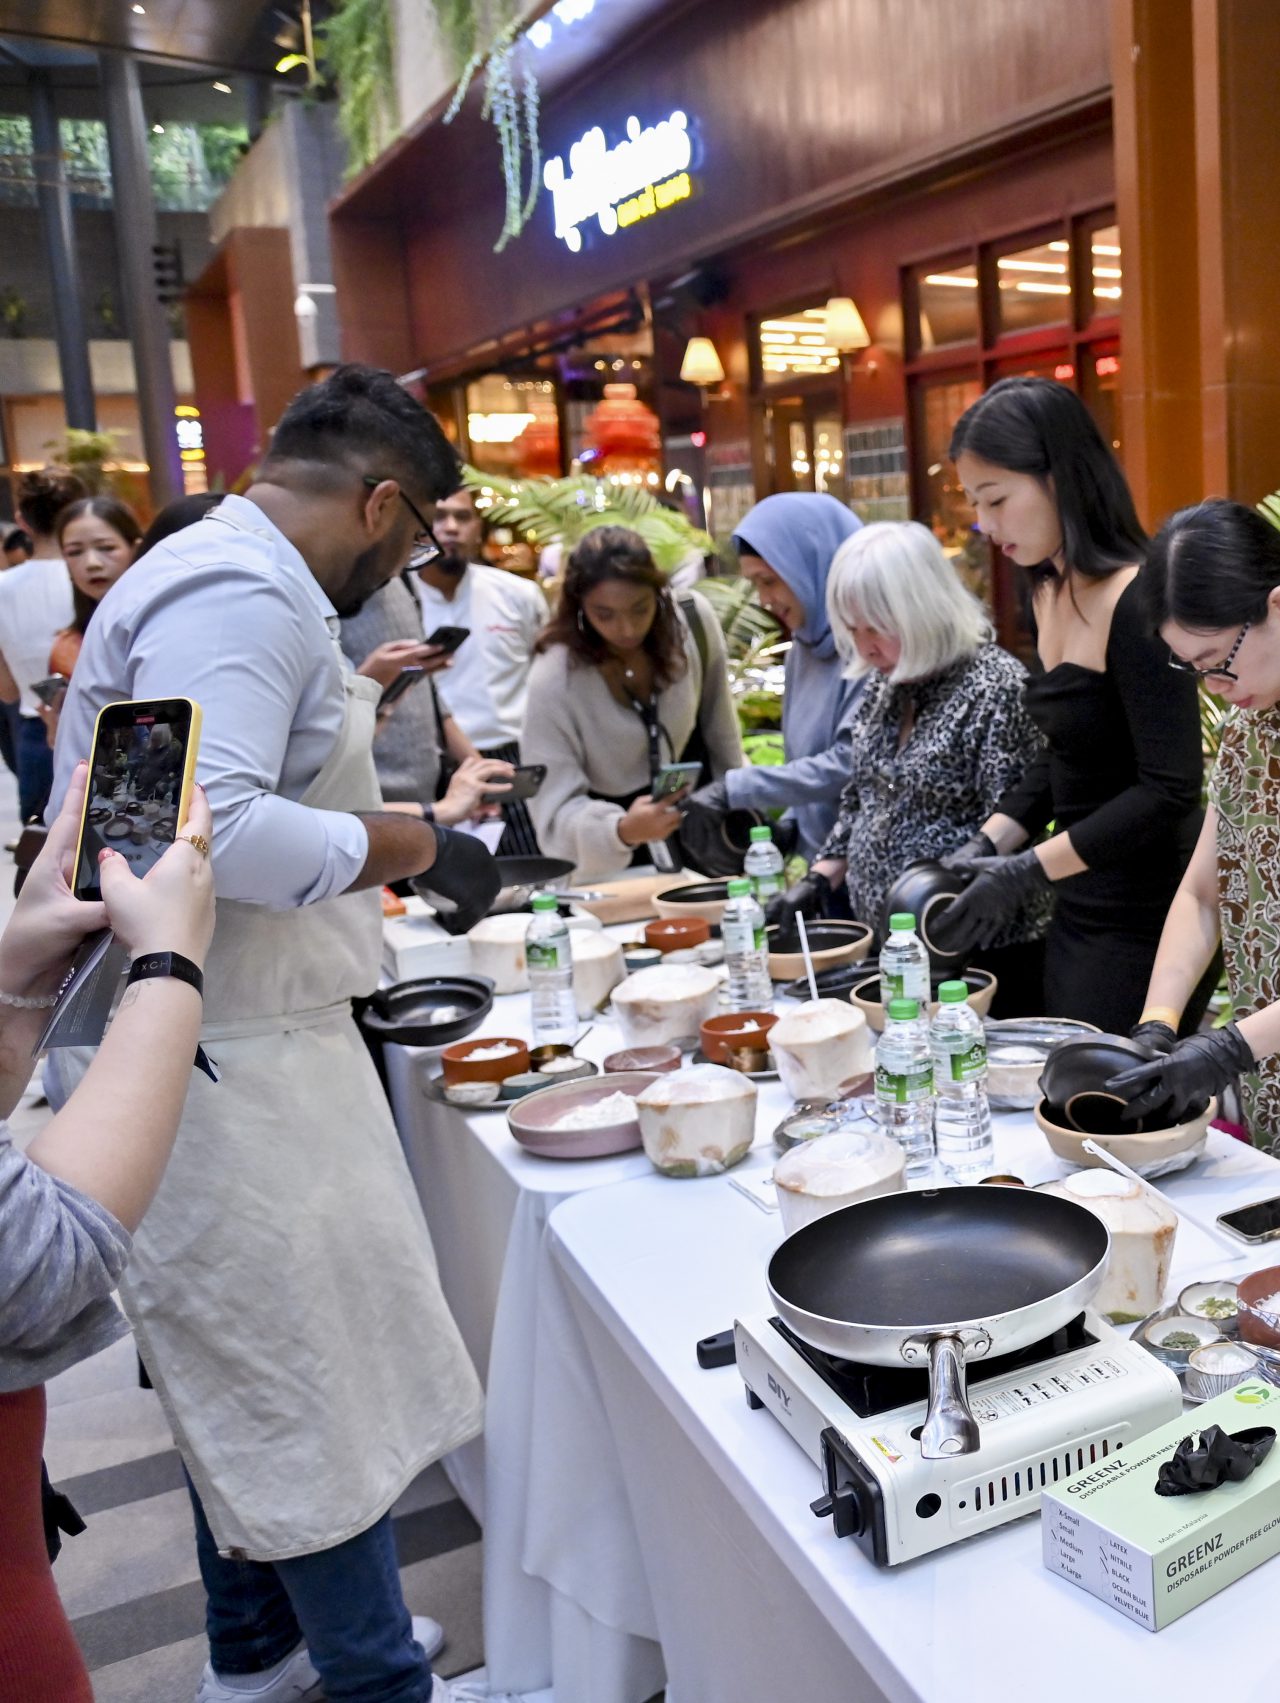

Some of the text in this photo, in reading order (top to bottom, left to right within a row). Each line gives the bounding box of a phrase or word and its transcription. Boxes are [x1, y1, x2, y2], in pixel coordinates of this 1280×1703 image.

[767, 1372, 791, 1408] DIY
[1067, 1459, 1128, 1494] GREENZ
[1079, 1471, 1126, 1500] DISPOSABLE
[1126, 1454, 1160, 1473] POWDER
[1156, 1443, 1179, 1456] FREE
[1059, 1508, 1080, 1527] X-Small
[1158, 1533, 1176, 1544] Made
[1182, 1513, 1209, 1530] Malaysia
[1059, 1522, 1075, 1536] Small
[1060, 1536, 1084, 1555] Medium
[1060, 1549, 1076, 1564] Large
[1110, 1539, 1128, 1555] LATEX
[1166, 1532, 1224, 1578] GREENZ
[1061, 1562, 1082, 1580] X-Large
[1110, 1553, 1132, 1572] NITRILE
[1167, 1559, 1213, 1593] DISPOSABLE
[1214, 1539, 1245, 1565] POWDER
[1245, 1528, 1262, 1545] FREE
[1111, 1568, 1130, 1584] BLACK
[1112, 1582, 1147, 1608] OCEAN BLUE
[1113, 1593, 1150, 1622] VELVET BLUE
